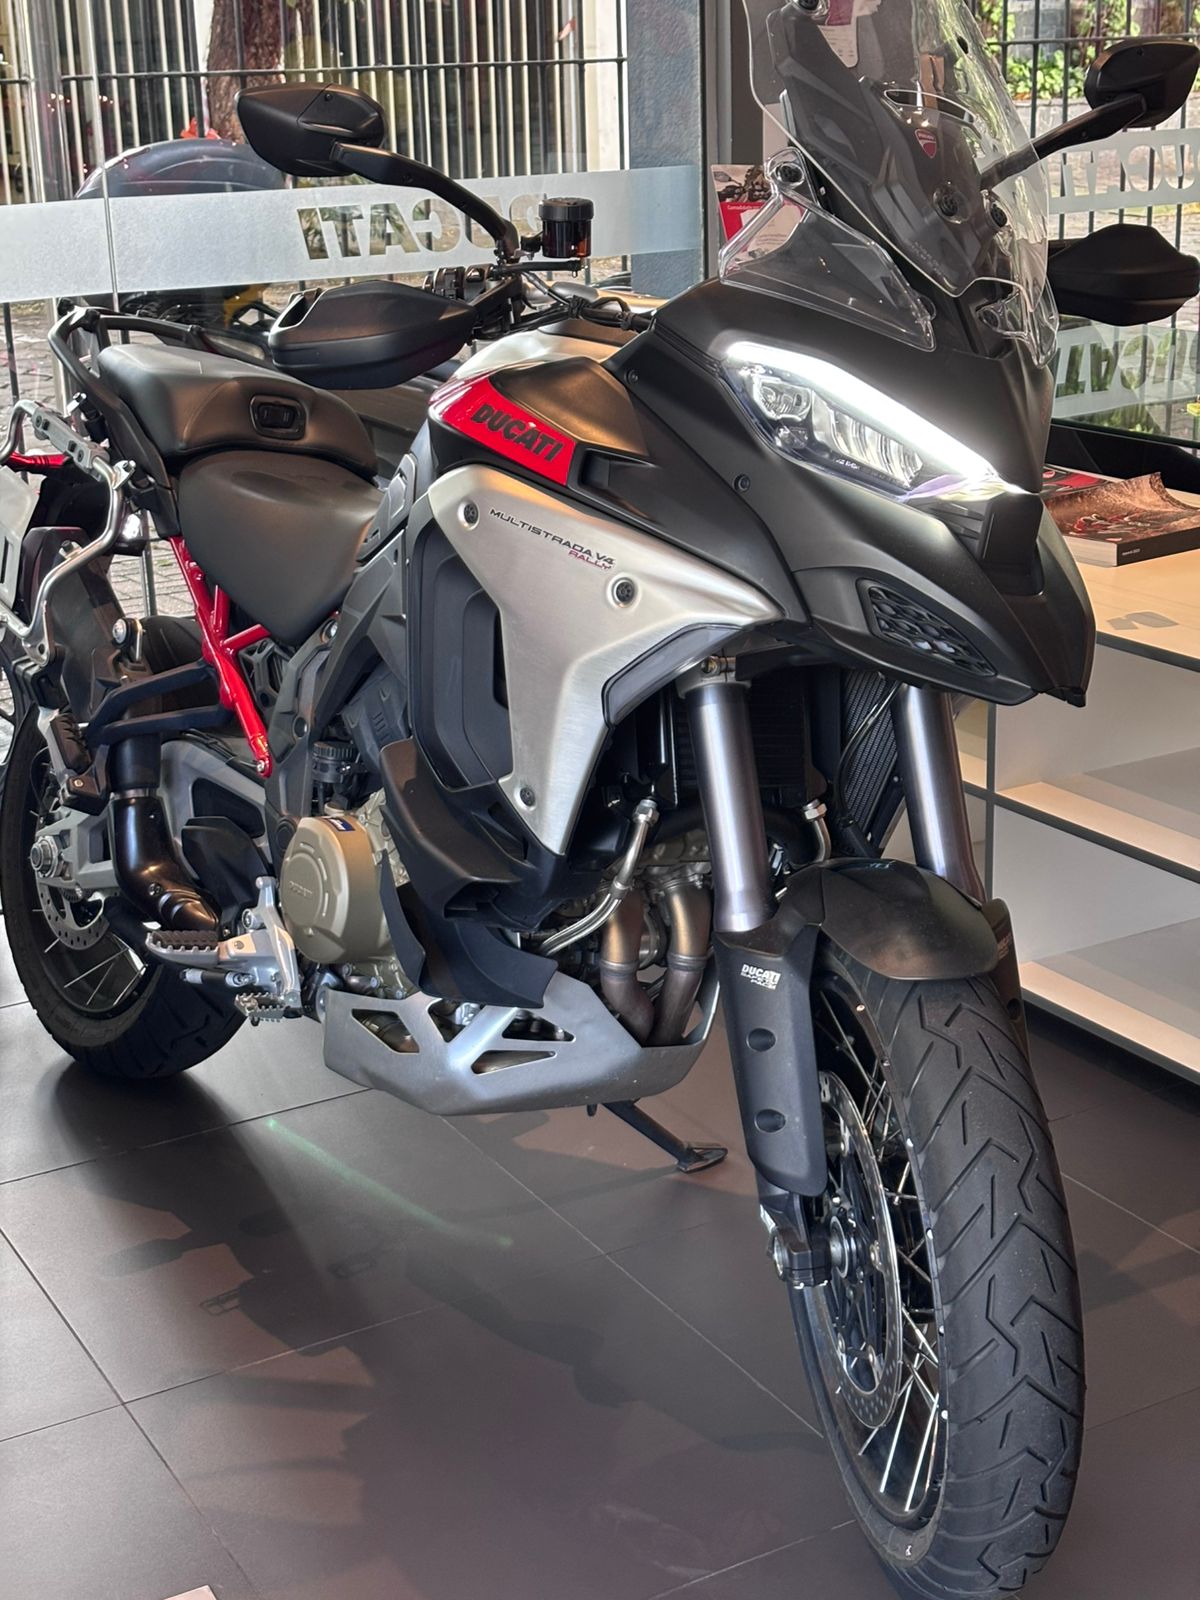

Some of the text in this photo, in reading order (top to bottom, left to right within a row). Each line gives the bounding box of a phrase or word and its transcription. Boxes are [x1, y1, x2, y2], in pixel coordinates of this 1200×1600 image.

[471, 403, 564, 462] DUCATI
[489, 508, 616, 565] MULTISTRADA V4
[568, 549, 612, 570] RALLY
[741, 963, 781, 985] DUCATI
